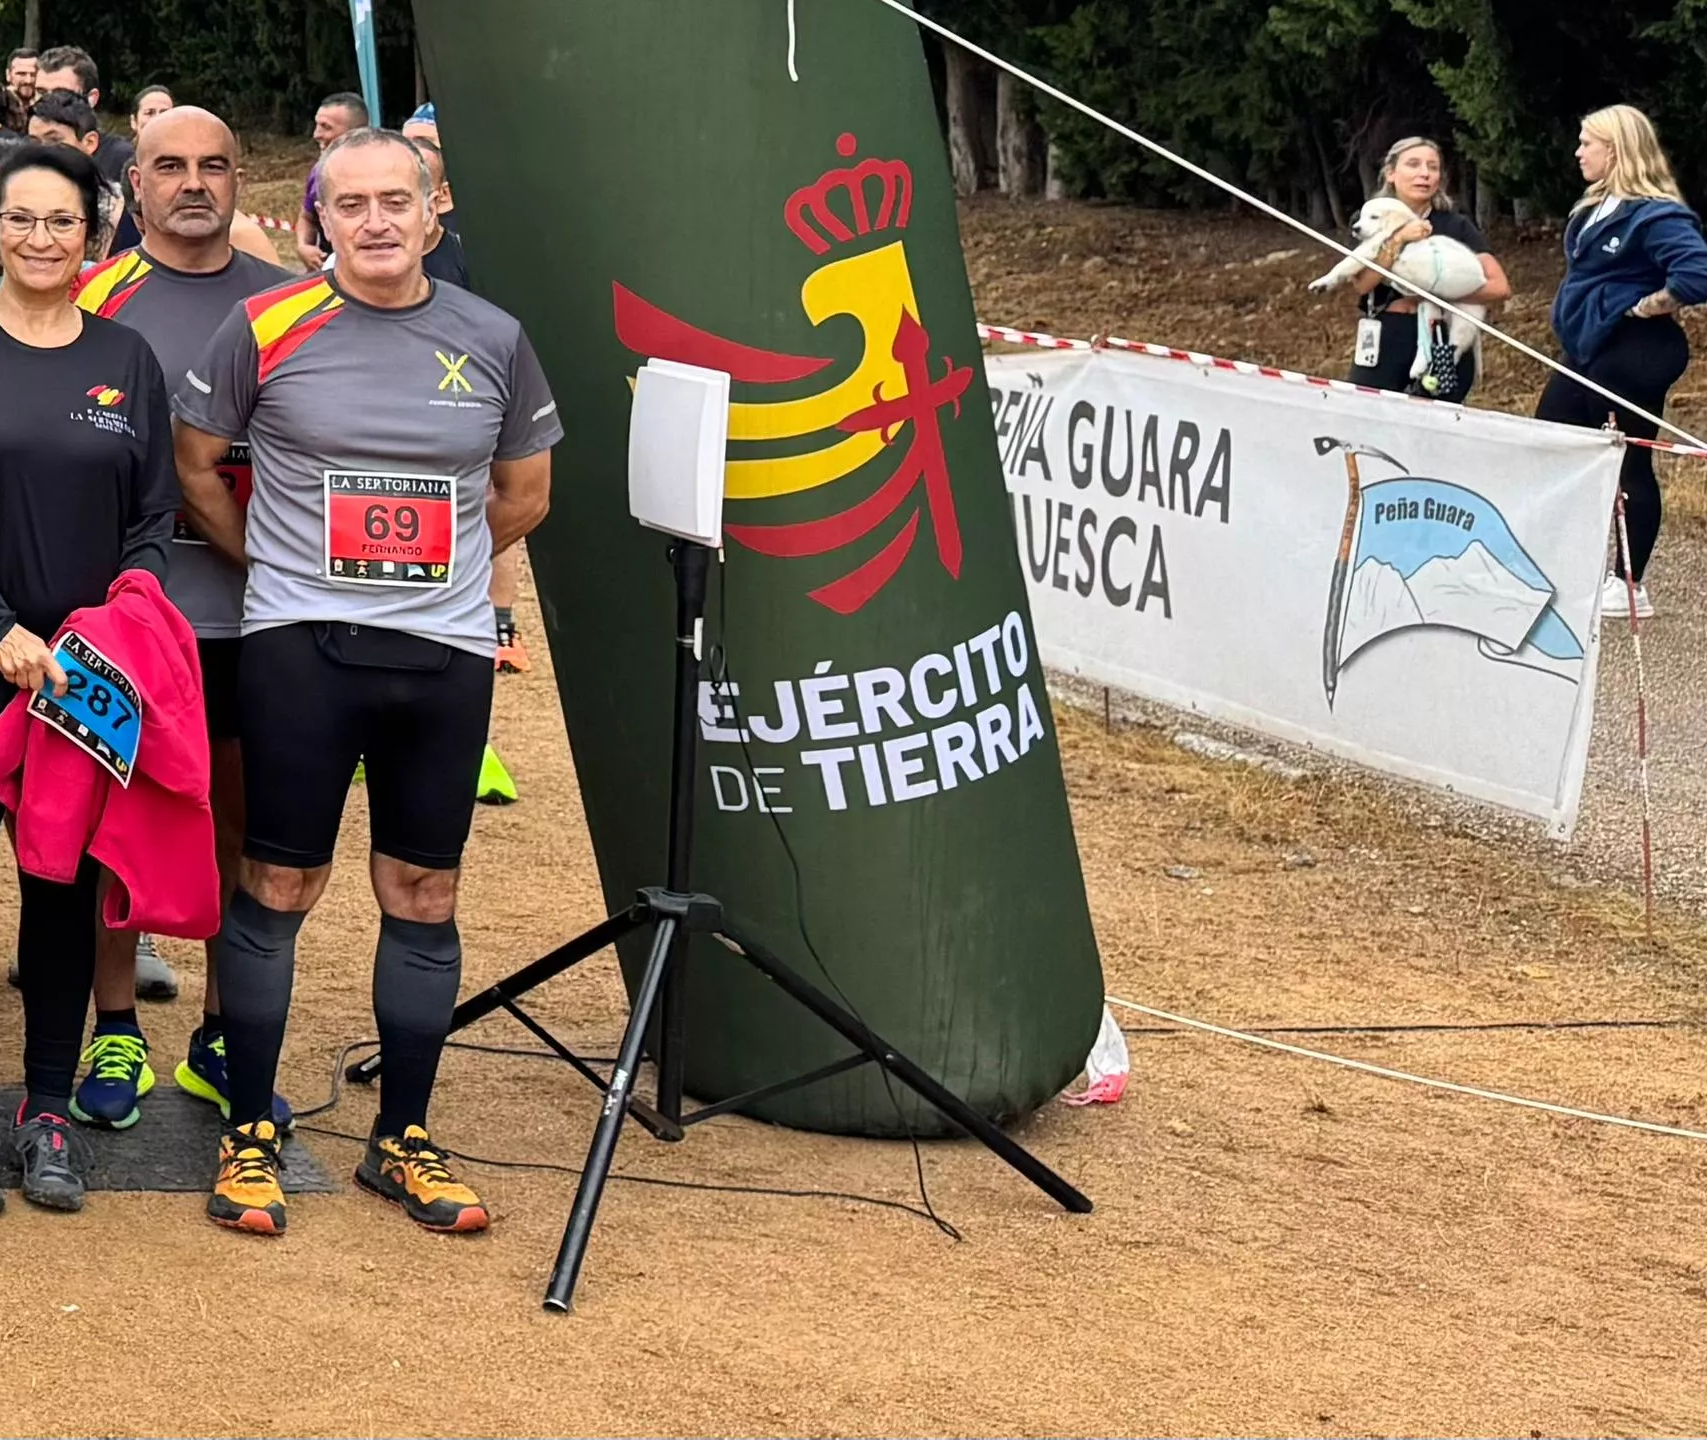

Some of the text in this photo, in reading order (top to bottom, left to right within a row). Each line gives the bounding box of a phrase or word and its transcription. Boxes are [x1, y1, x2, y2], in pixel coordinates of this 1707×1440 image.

[1068, 400, 1232, 524] GUARA
[330, 477, 450, 494] LA SERTORIANA
[365, 503, 420, 542] 69
[1375, 497, 1476, 532] Peña Guara
[362, 543, 423, 556] FERNANDO
[65, 635, 80, 654] LA
[698, 611, 1029, 743] EJÉRCITO
[65, 668, 133, 731] 287
[709, 682, 1045, 814] DE TIERRA
